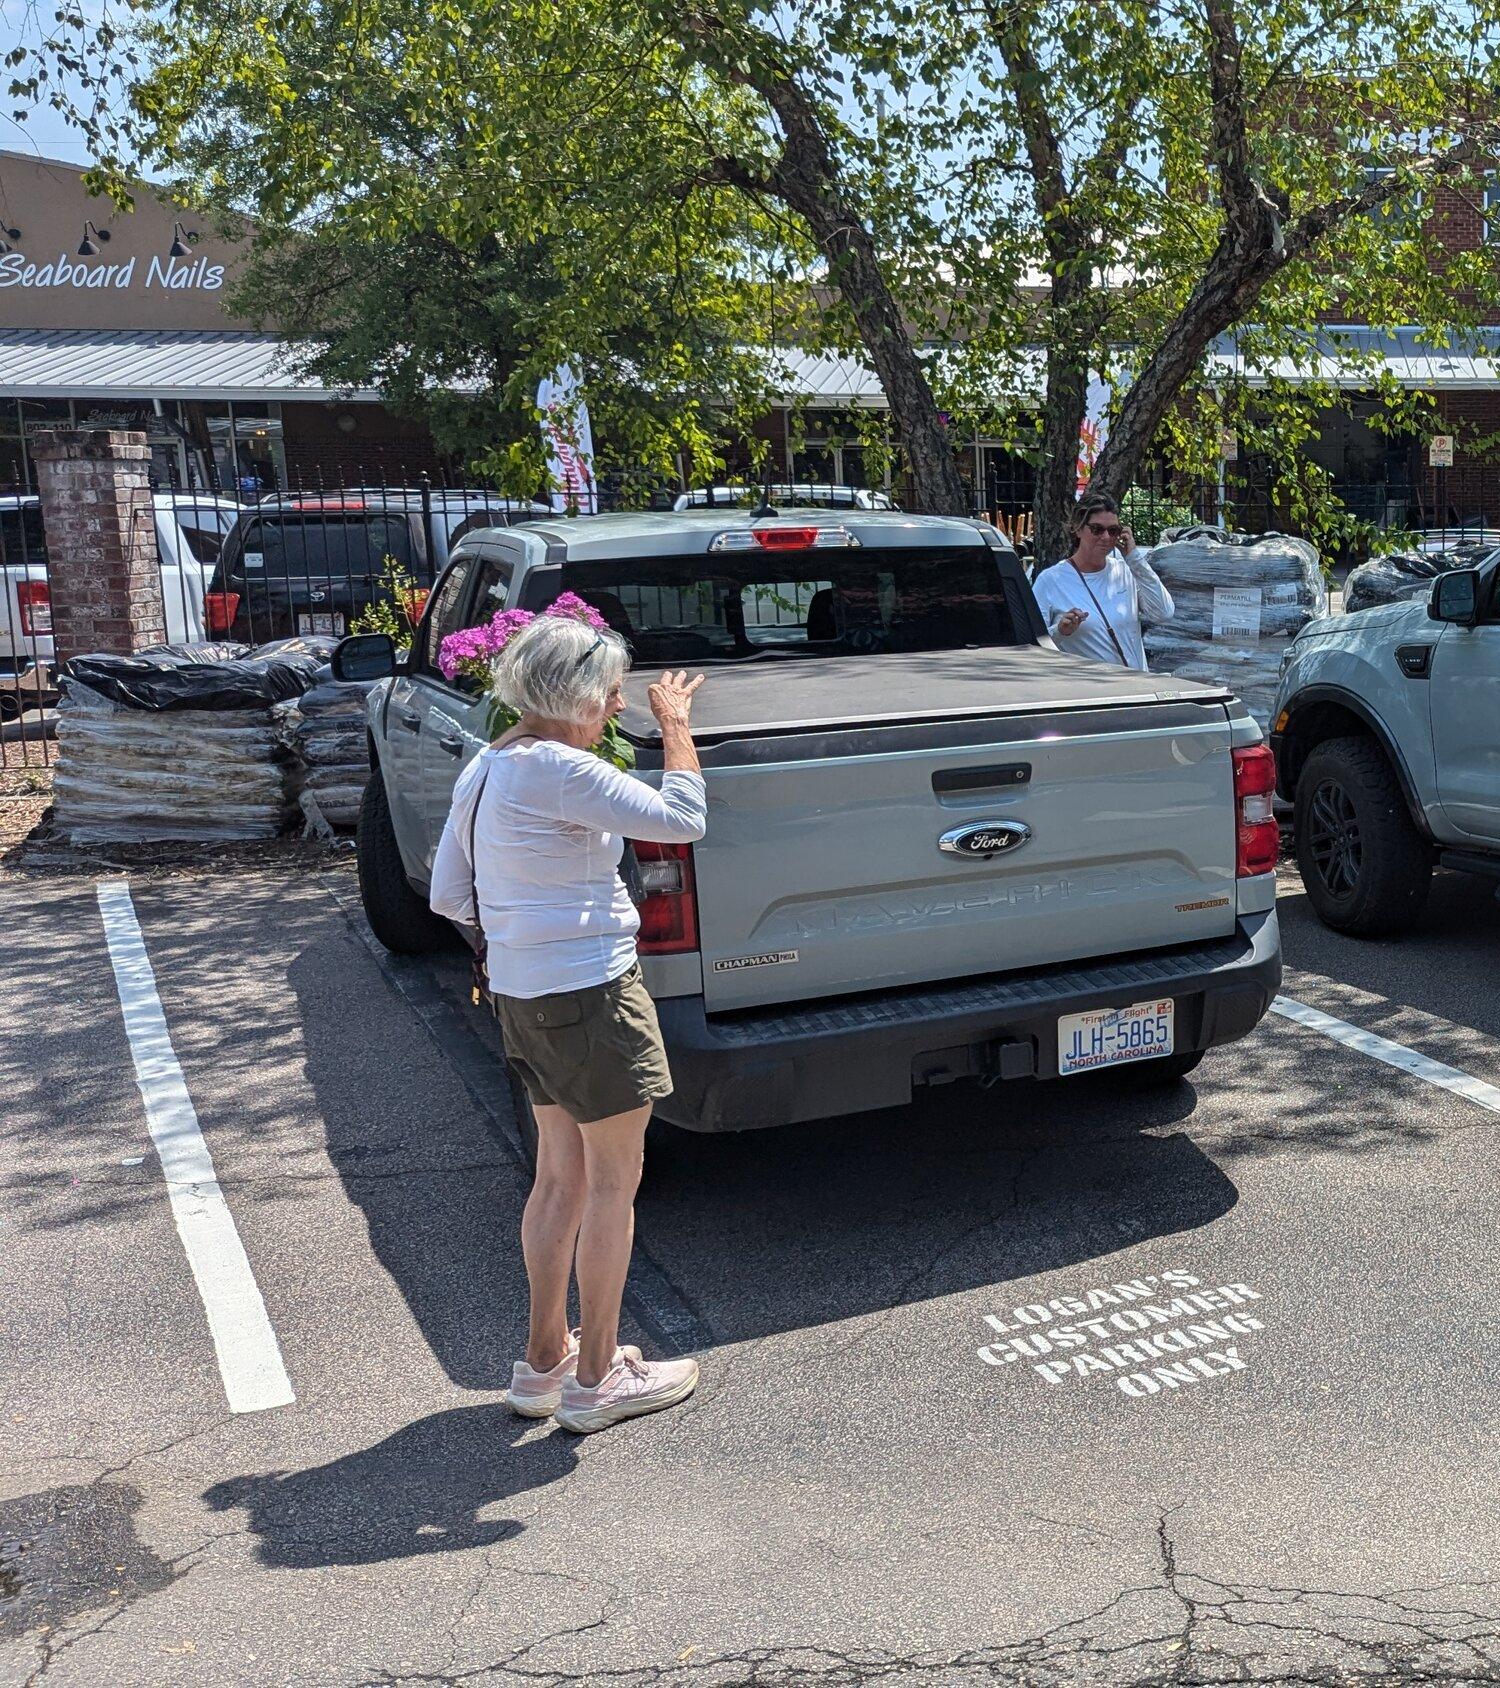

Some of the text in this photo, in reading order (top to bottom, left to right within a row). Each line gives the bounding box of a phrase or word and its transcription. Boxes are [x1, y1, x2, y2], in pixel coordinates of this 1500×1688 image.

[0, 253, 226, 290] Seaboard Nails
[969, 830, 1010, 850] Ford
[716, 954, 778, 971] CHAPMAN
[1065, 1015, 1168, 1060] JLH-5865
[1069, 1044, 1164, 1069] NORTH CAROLINA
[982, 1268, 1200, 1334] LOGAN'S
[976, 1282, 1264, 1366] CUSTOMER
[1032, 1311, 1266, 1384] PARKING
[1116, 1346, 1248, 1397] ONLY
